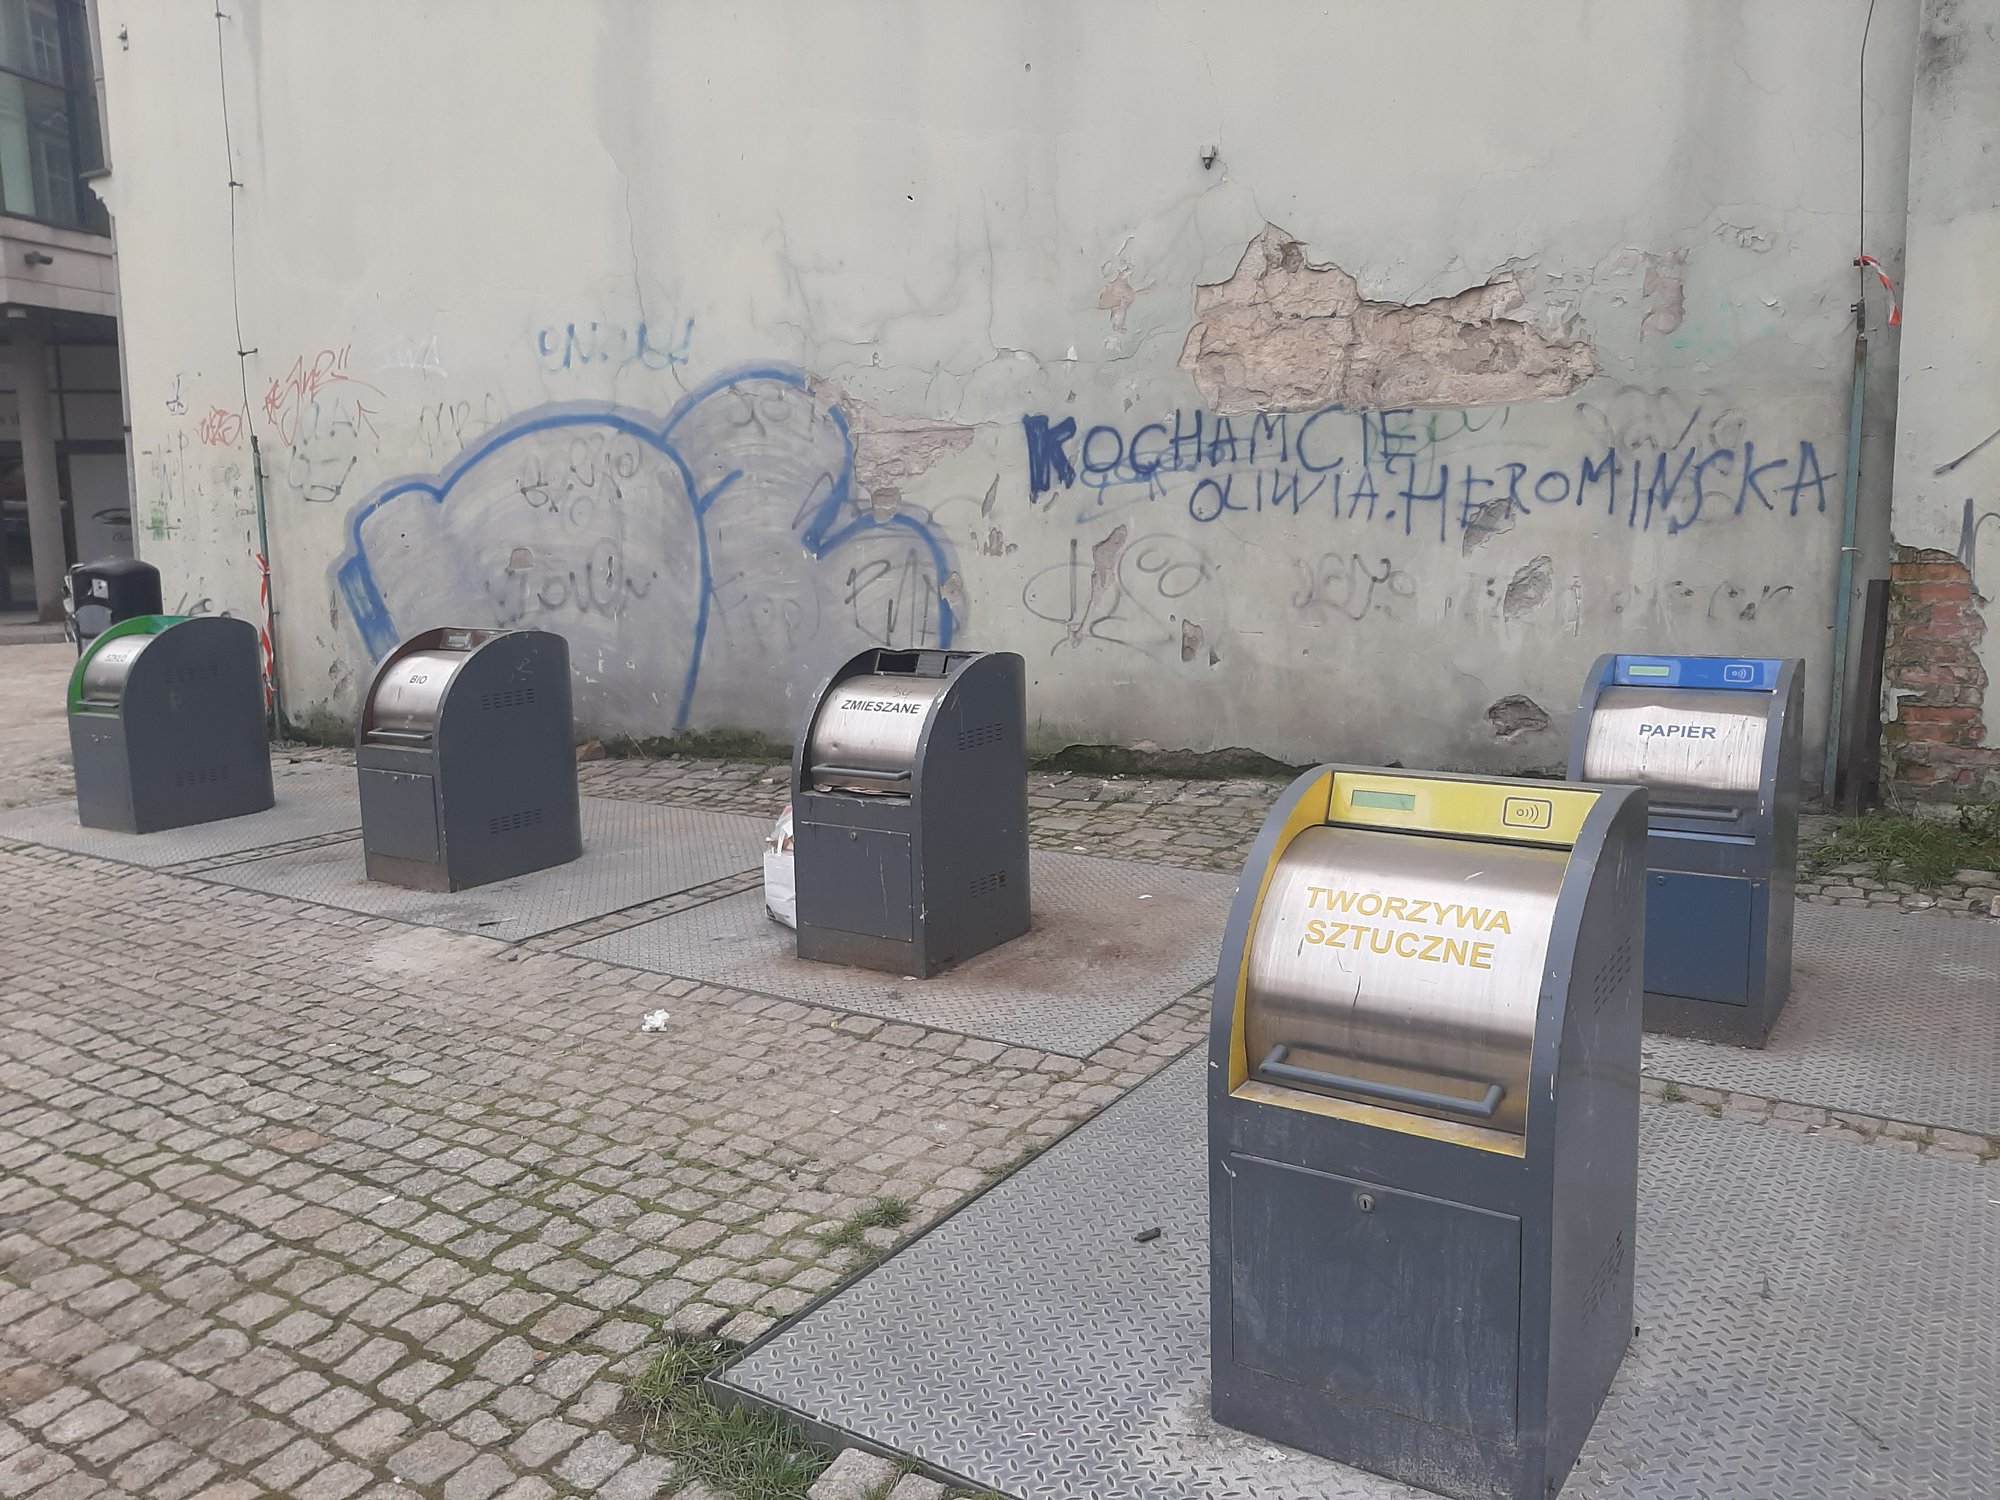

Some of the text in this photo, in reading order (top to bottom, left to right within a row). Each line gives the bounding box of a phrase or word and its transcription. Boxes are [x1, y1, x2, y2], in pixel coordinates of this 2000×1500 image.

[409, 674, 428, 684] BIO
[841, 699, 922, 715] ZMIESZANE
[1638, 723, 1717, 740] PAPIER
[1306, 886, 1513, 935] TWORZYWA
[1304, 919, 1495, 970] SZTUCZNE
